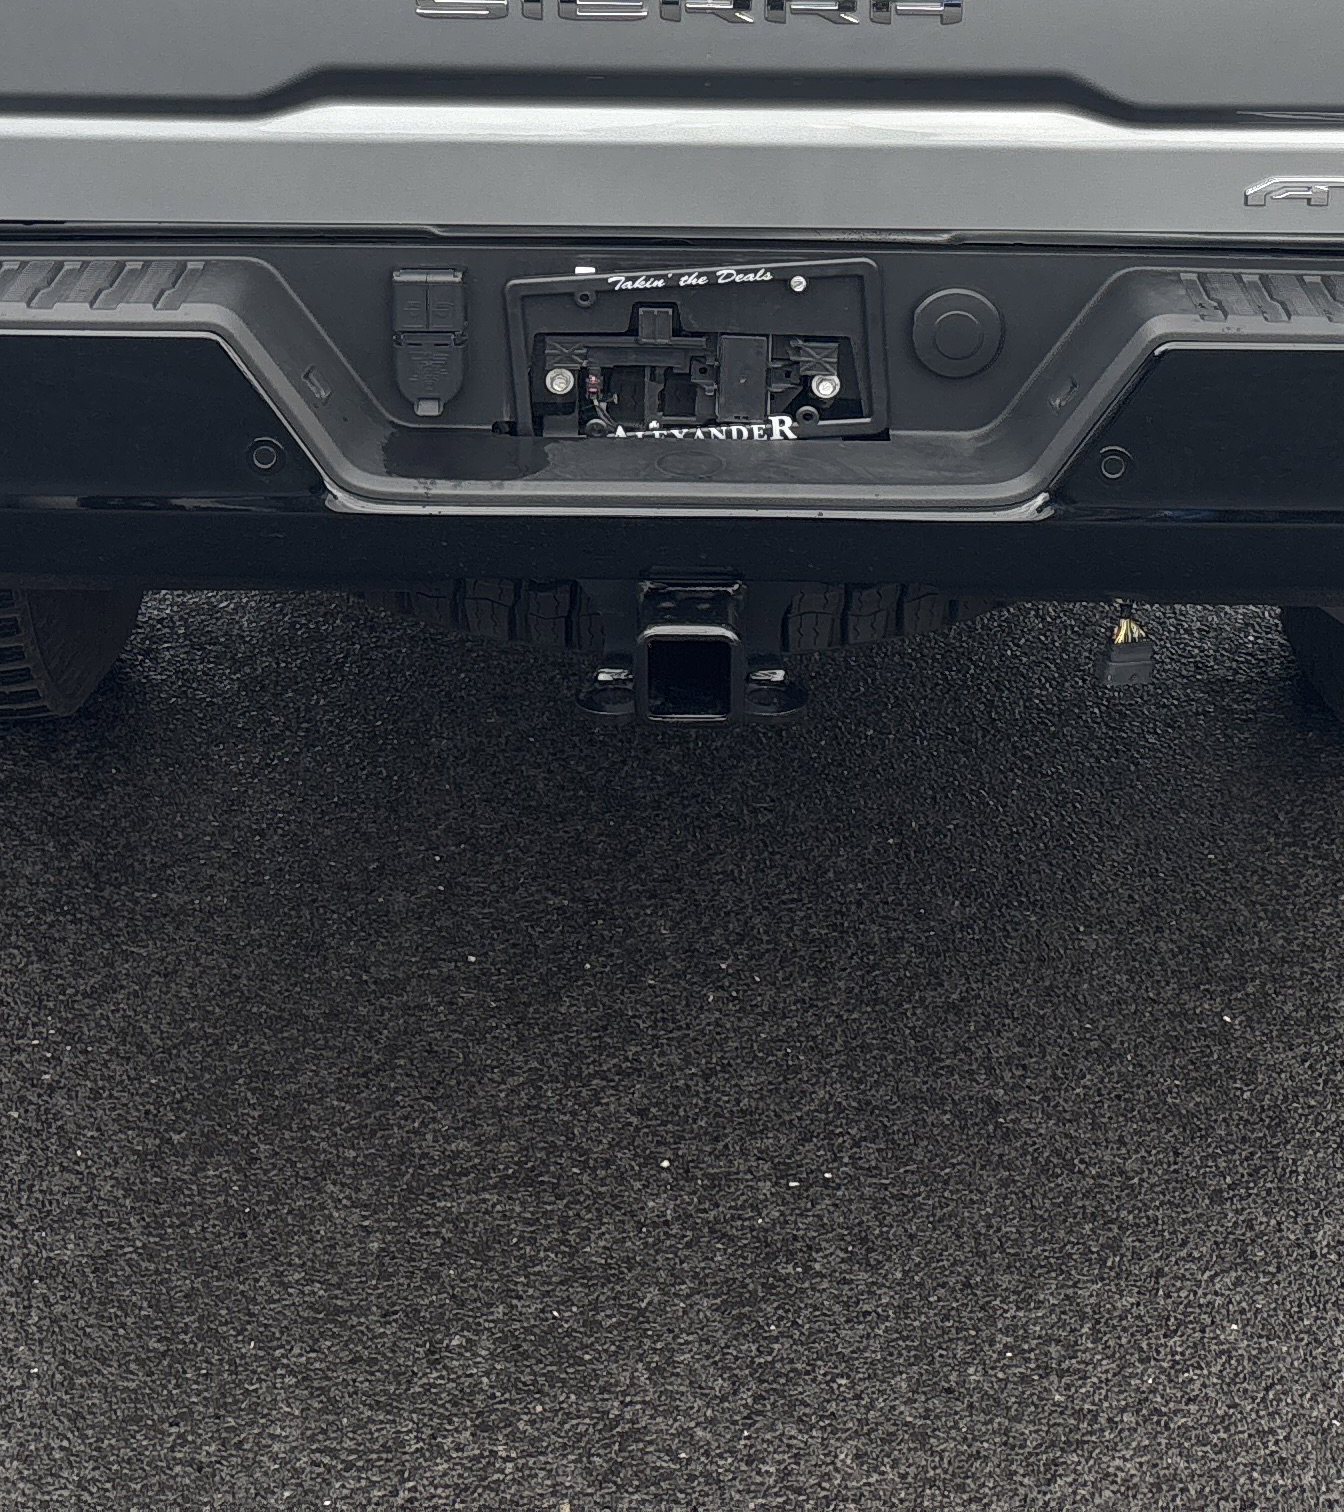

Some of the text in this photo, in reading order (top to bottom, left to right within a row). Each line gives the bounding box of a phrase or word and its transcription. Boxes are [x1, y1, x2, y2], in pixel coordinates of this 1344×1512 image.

[607, 267, 774, 291] Takin' the Deals
